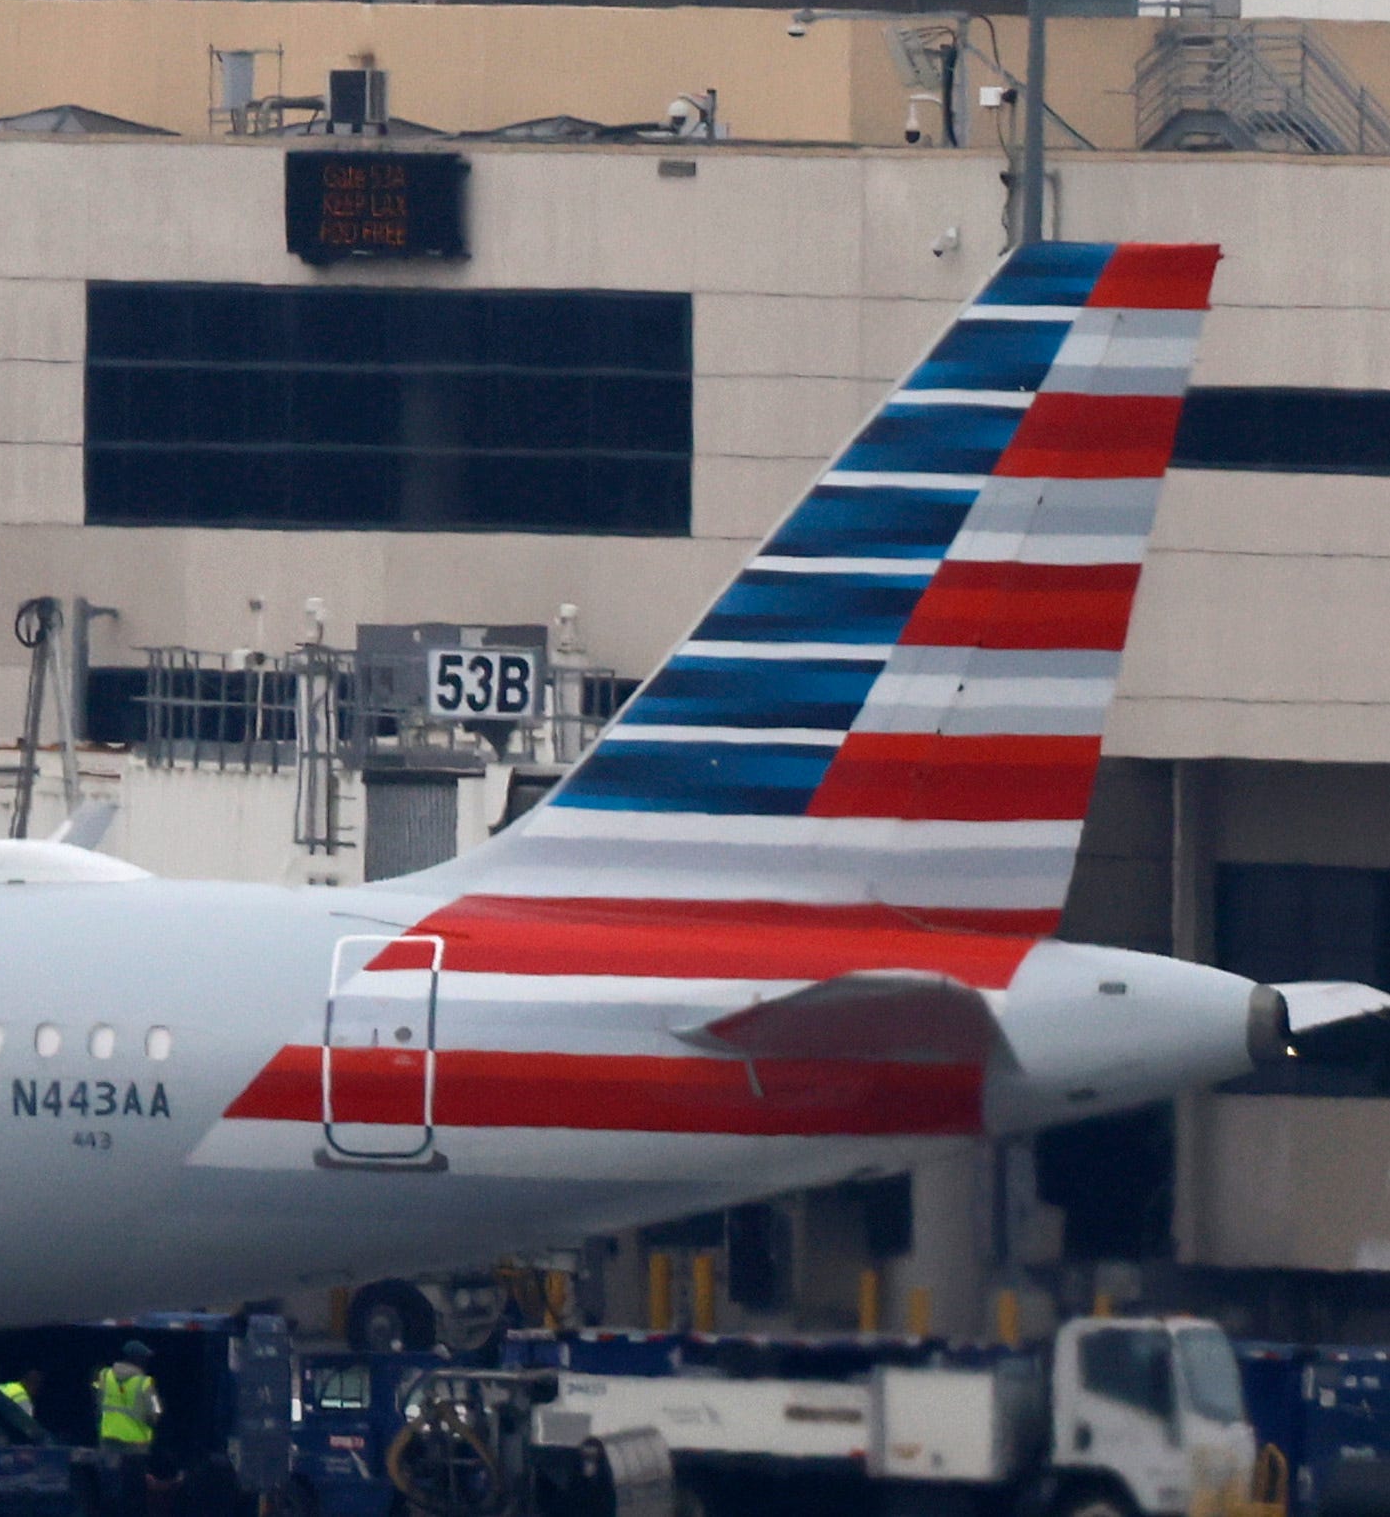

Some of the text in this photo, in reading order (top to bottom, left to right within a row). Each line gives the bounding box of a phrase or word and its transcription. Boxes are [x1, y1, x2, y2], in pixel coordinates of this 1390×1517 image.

[436, 653, 530, 713] 53B
[12, 1078, 170, 1118] N443AA
[72, 1131, 114, 1150] 443
